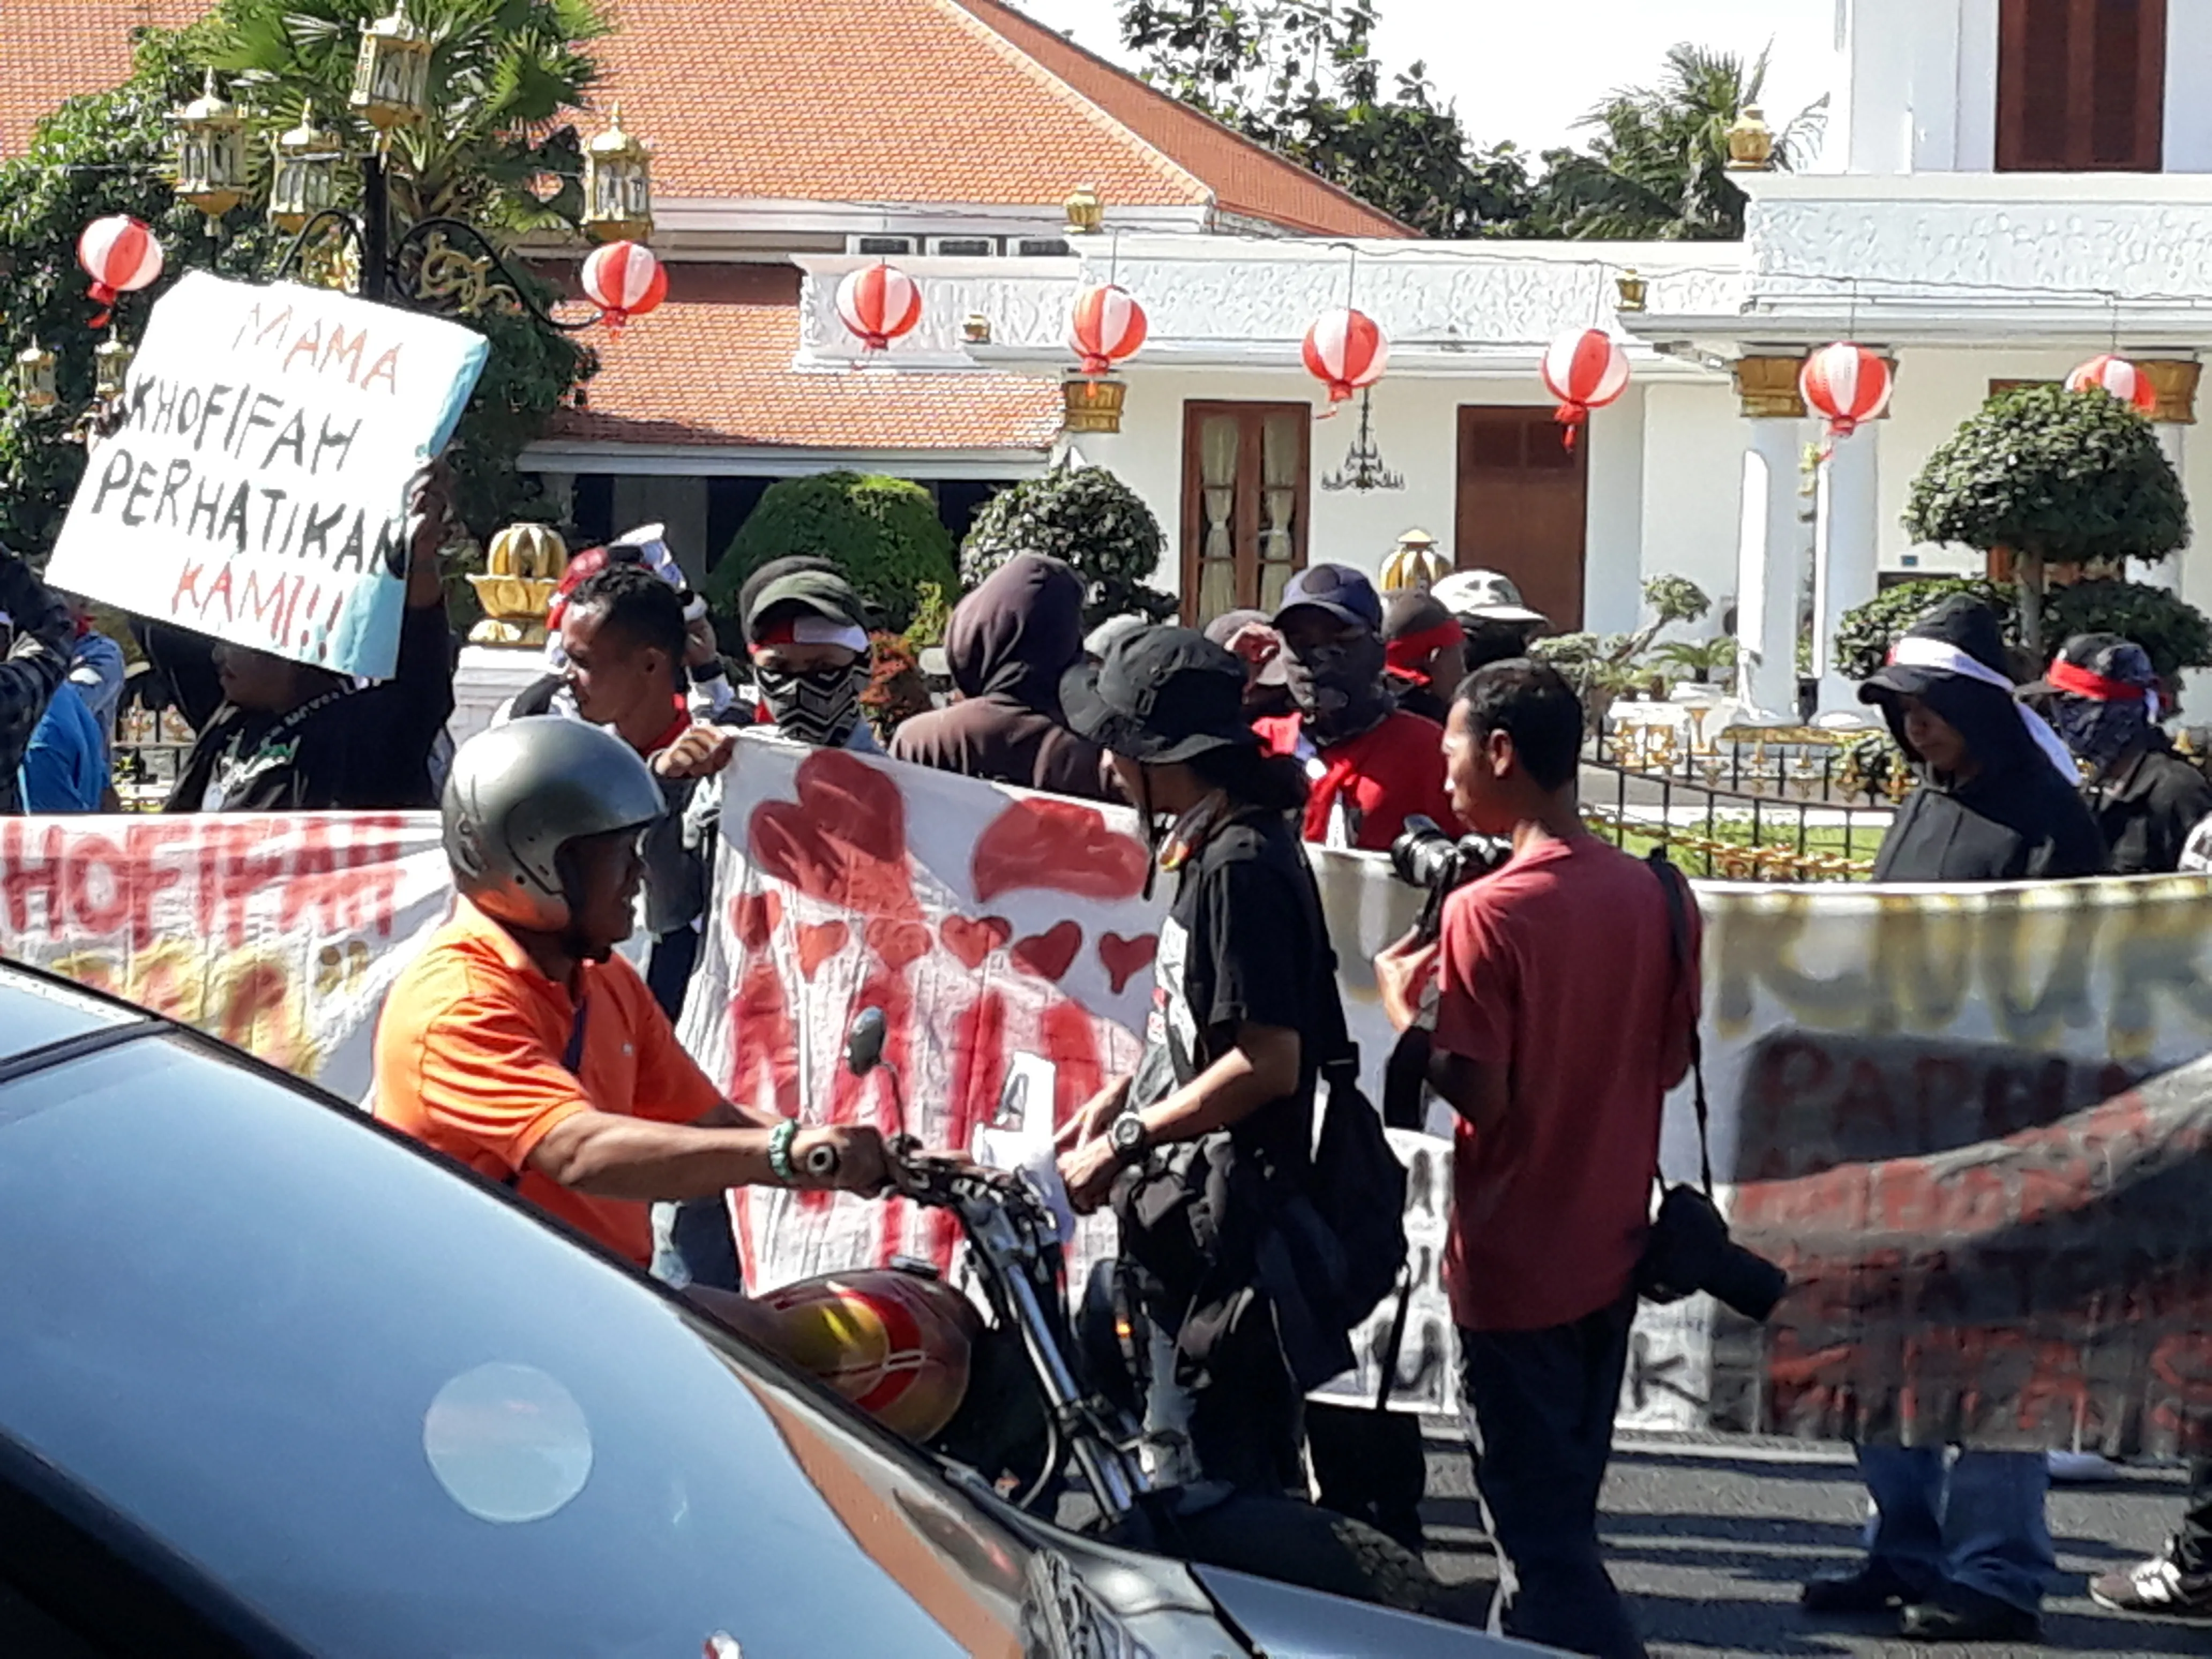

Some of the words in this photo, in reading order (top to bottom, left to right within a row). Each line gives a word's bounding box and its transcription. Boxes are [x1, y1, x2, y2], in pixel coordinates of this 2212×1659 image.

[233, 302, 405, 395] MAMA
[123, 373, 363, 475] KHOFIFAH
[91, 449, 408, 576] PERHATIKAN
[171, 558, 343, 659] KAMI!!
